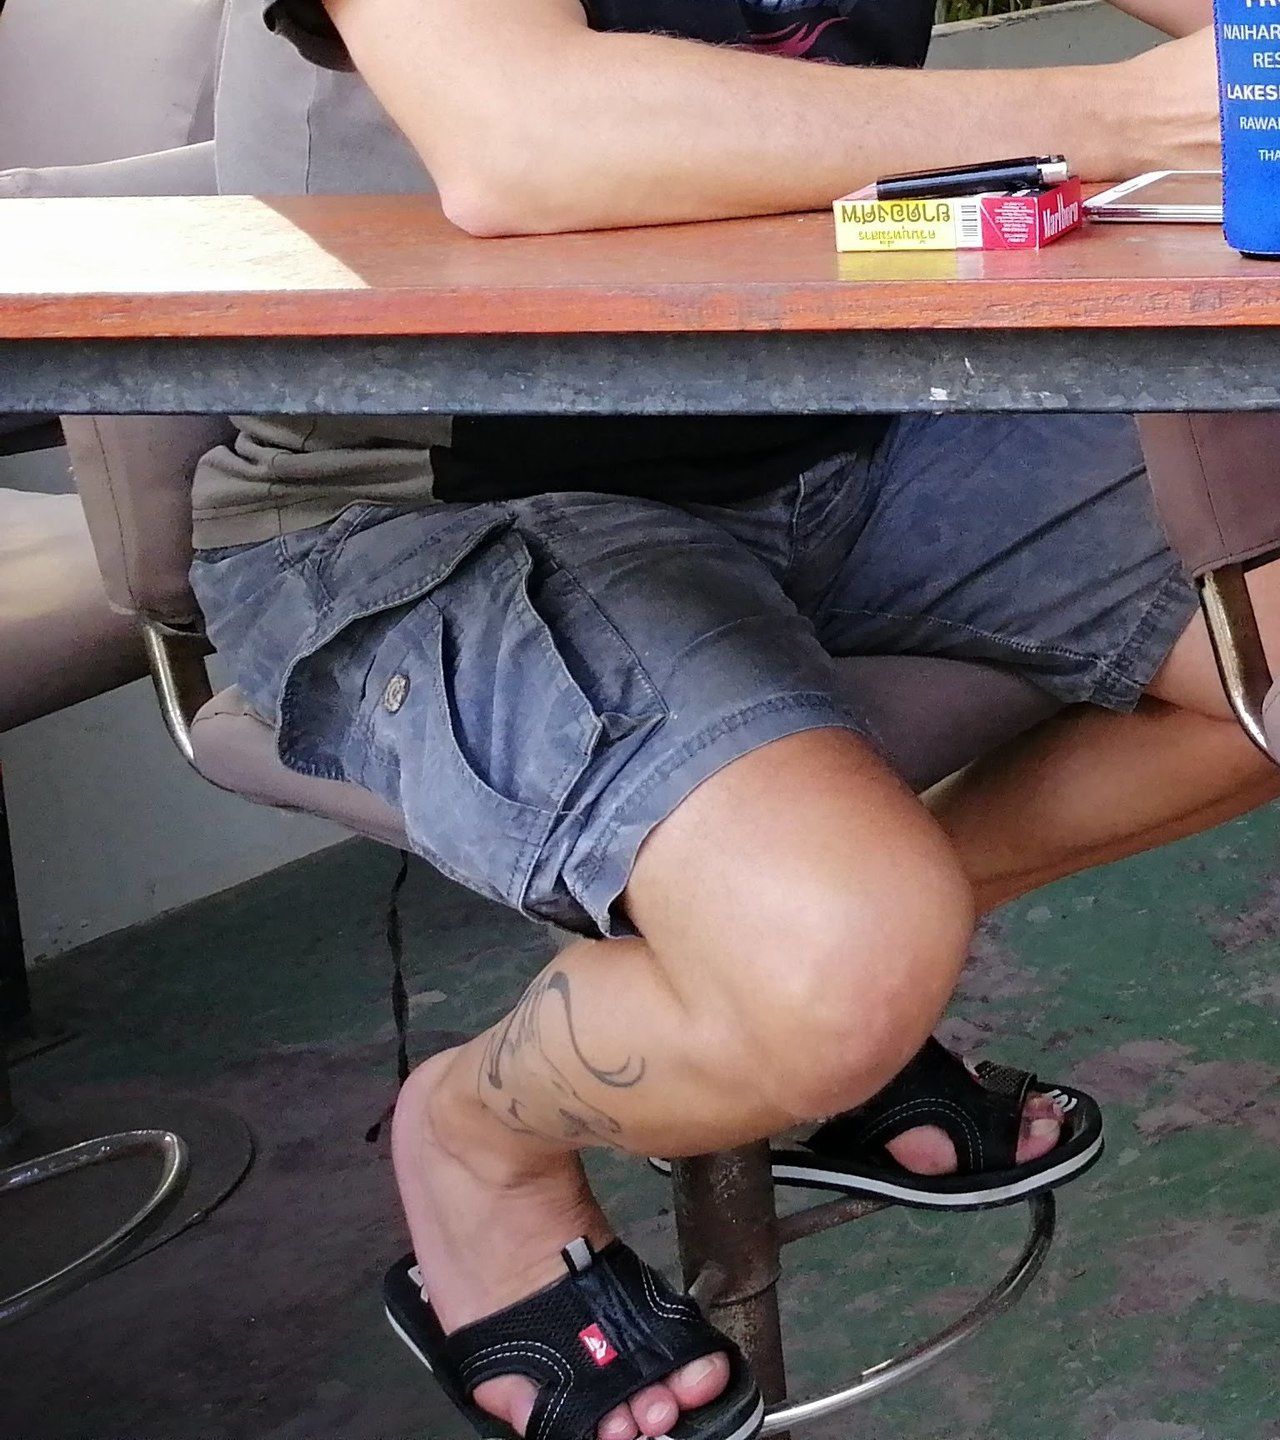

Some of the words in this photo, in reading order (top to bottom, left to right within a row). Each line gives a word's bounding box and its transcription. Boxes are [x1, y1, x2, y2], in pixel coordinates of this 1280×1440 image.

[841, 202, 952, 226] ยาดองศพ
[1042, 192, 1080, 240] Marlboro
